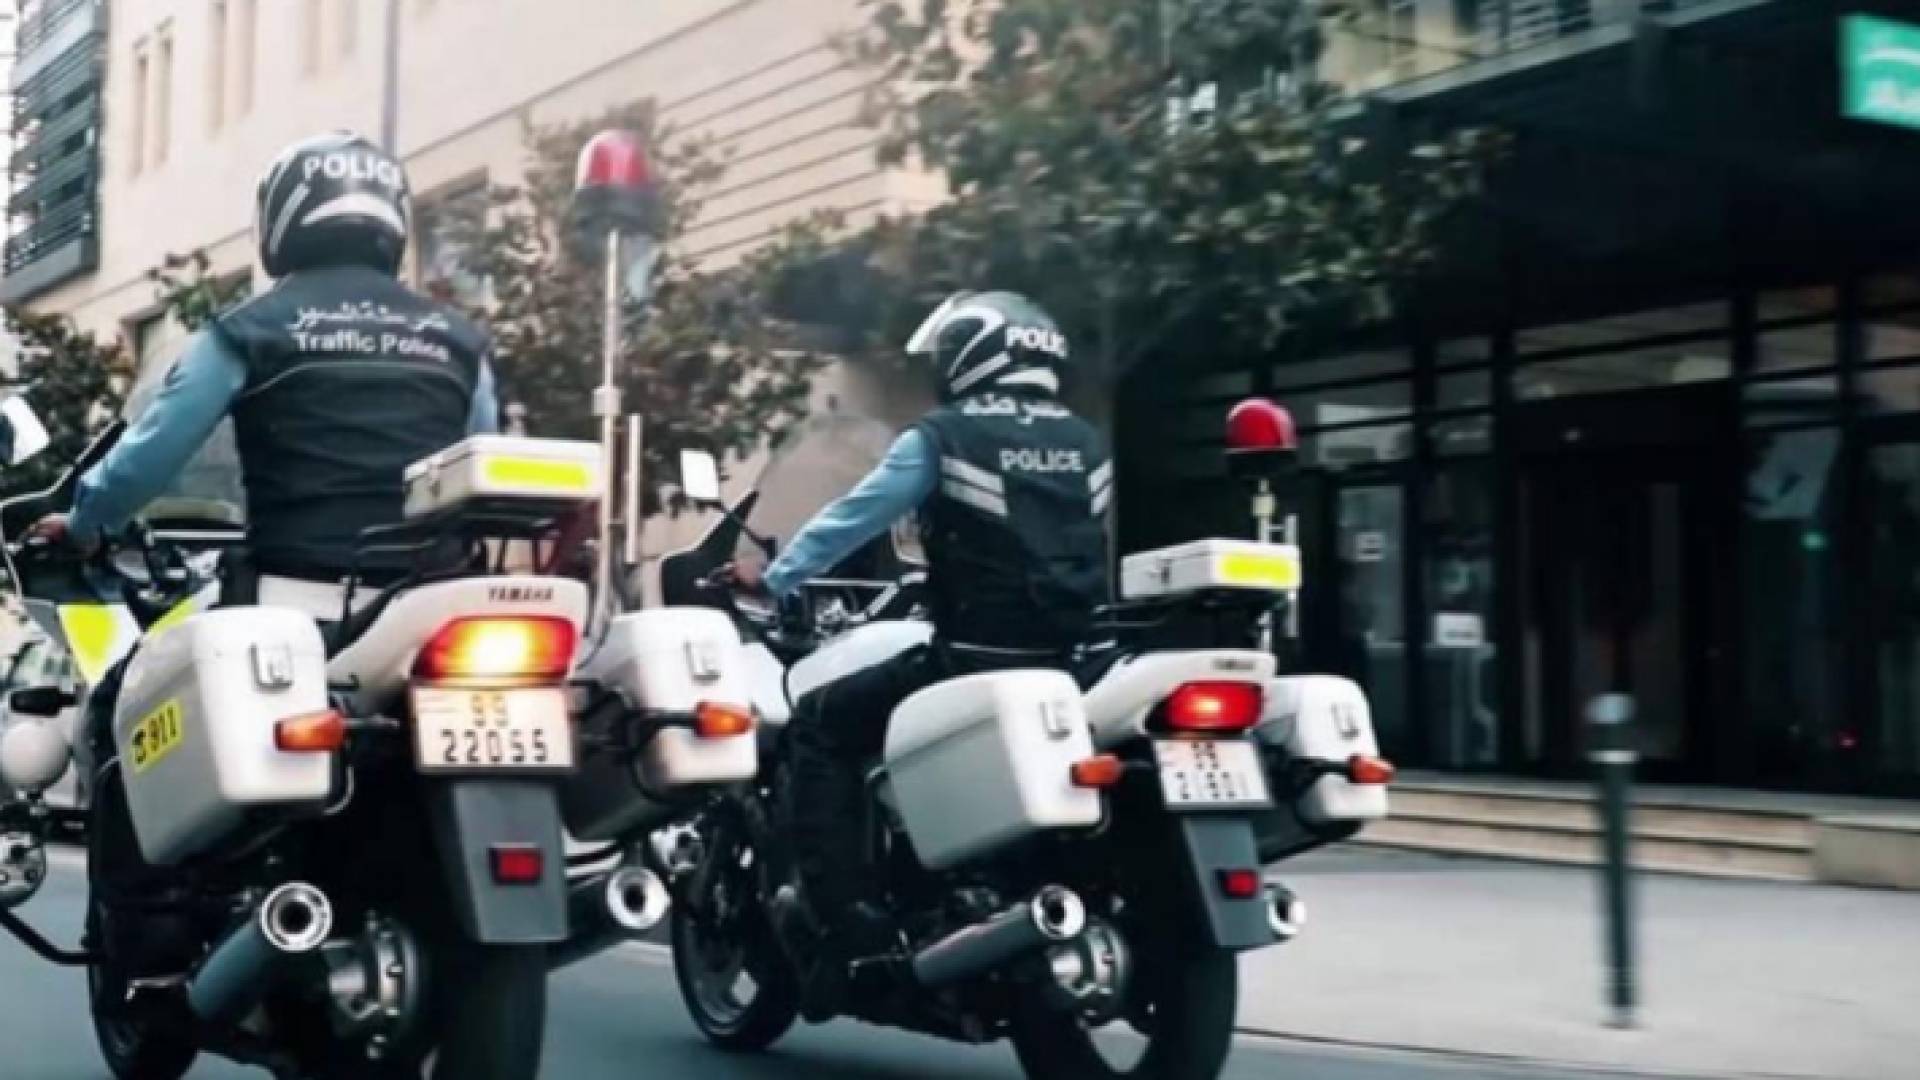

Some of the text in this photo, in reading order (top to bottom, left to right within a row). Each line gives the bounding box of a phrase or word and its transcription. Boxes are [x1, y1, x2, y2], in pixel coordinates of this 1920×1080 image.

[291, 328, 450, 362] Traffic Police
[999, 448, 1085, 473] POLICE
[487, 585, 554, 602] YAMAHA
[440, 727, 548, 763] 22055
